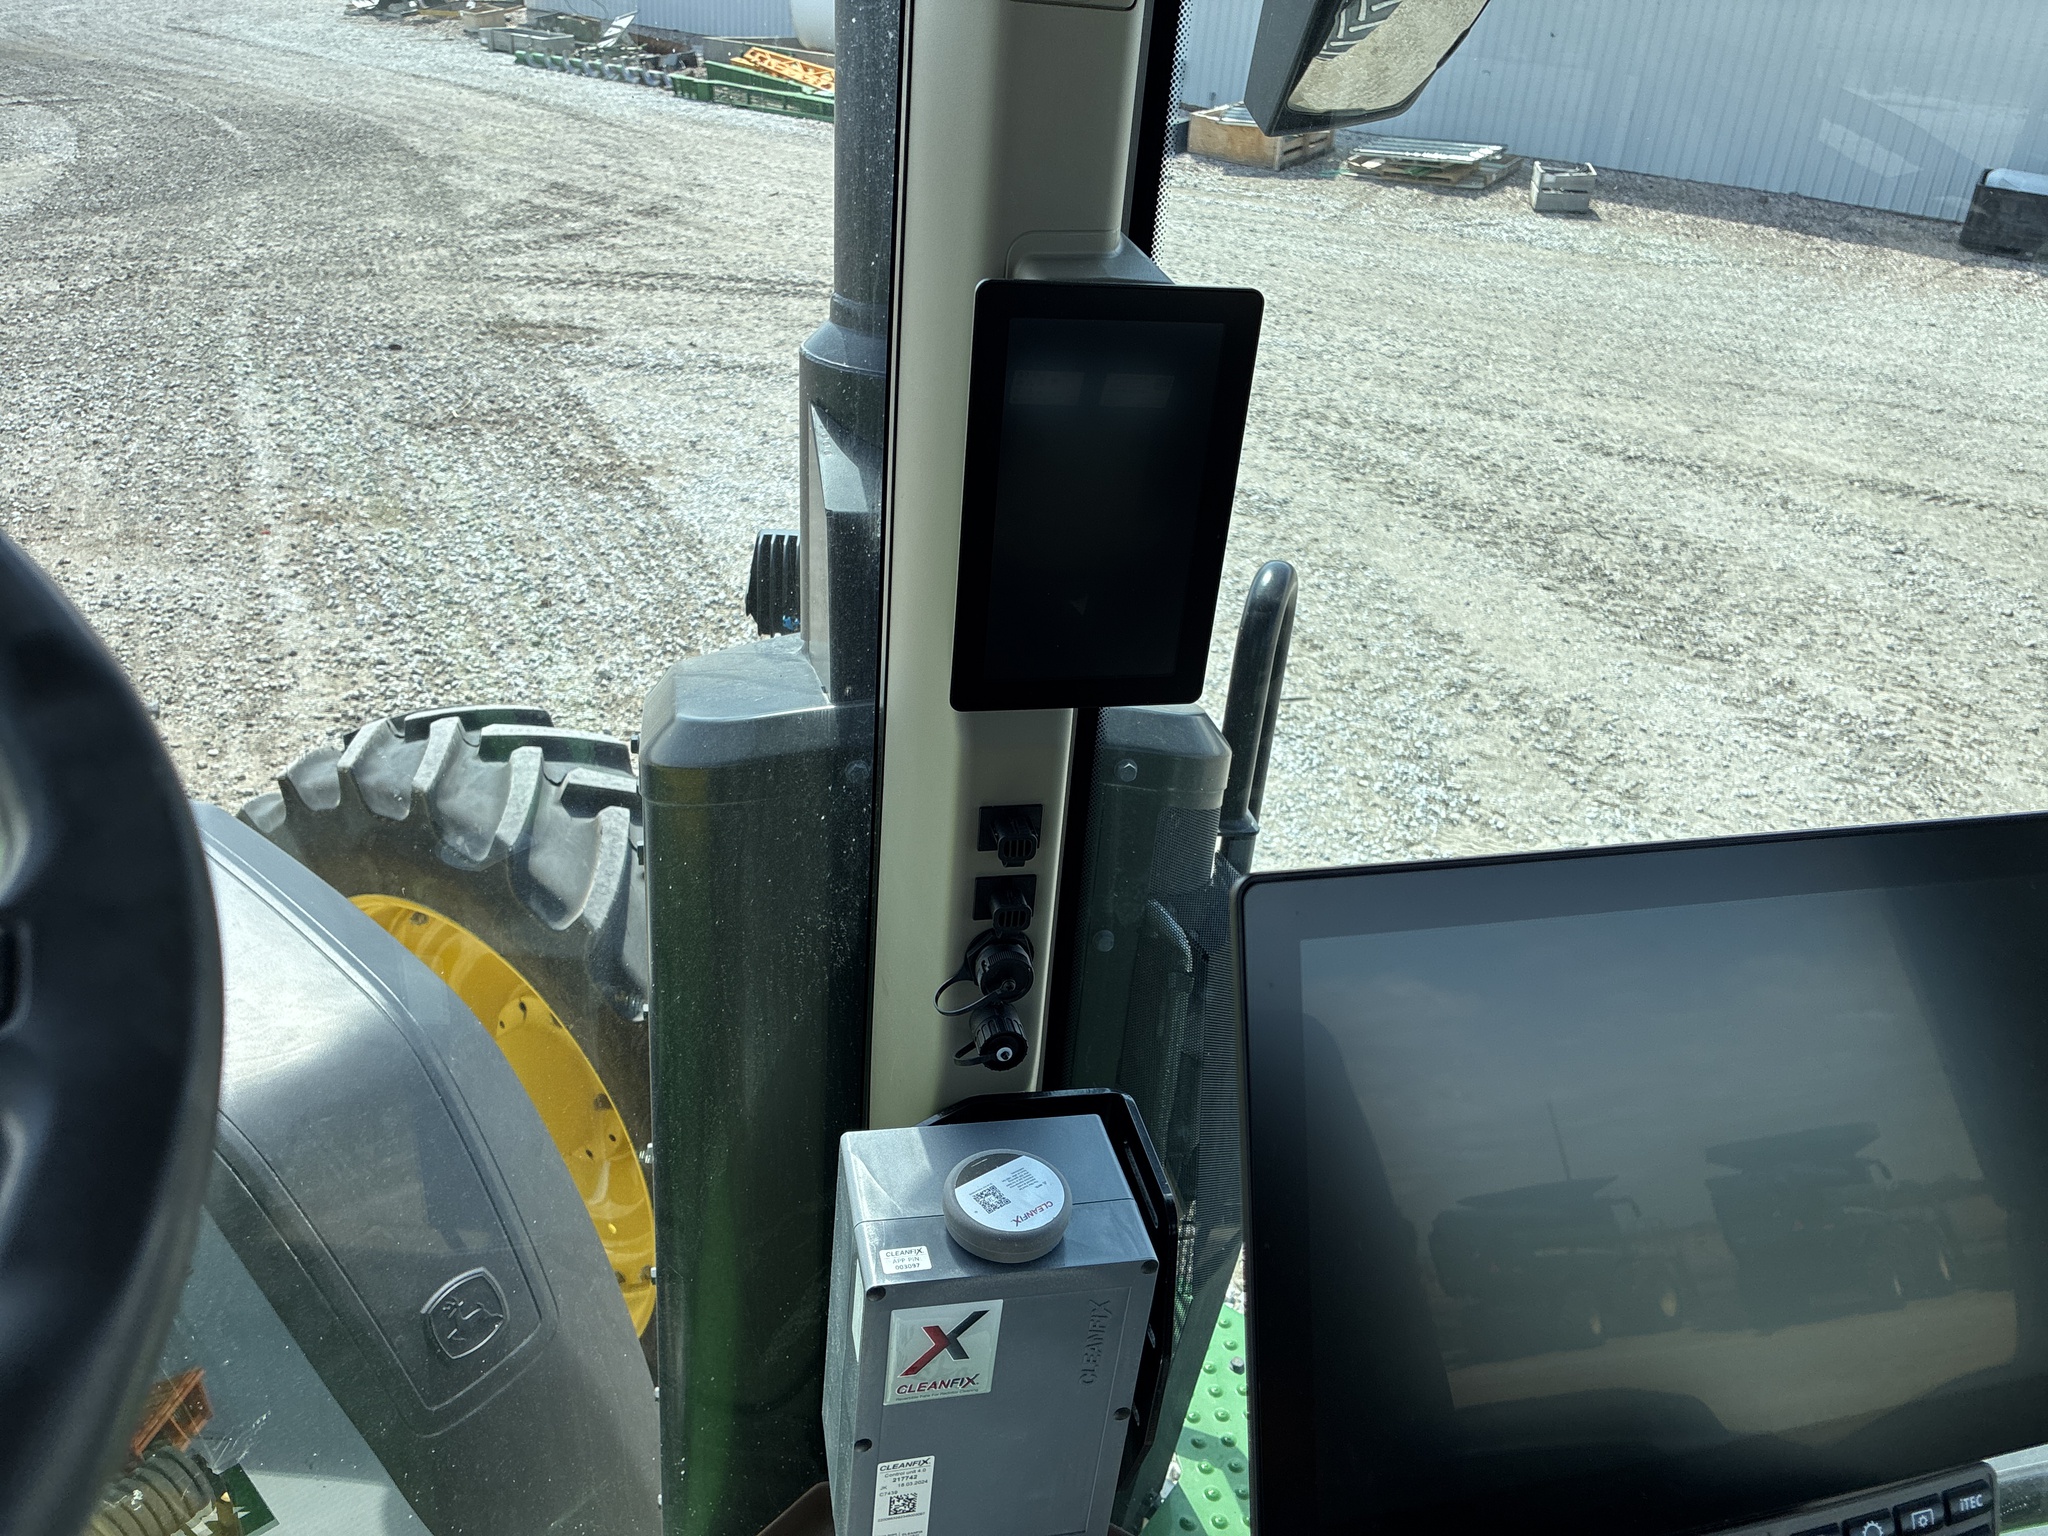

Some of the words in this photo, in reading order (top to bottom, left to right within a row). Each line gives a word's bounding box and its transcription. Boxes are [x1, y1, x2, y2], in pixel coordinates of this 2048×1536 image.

[886, 1247, 923, 1257] CLEANFIX
[1080, 1299, 1113, 1384] CLEANFIX
[896, 1374, 980, 1394] CLEANFIX
[880, 1458, 931, 1471] CLEANFIX
[892, 1475, 918, 1483] 217742
[1959, 1494, 1984, 1512] iTEC
